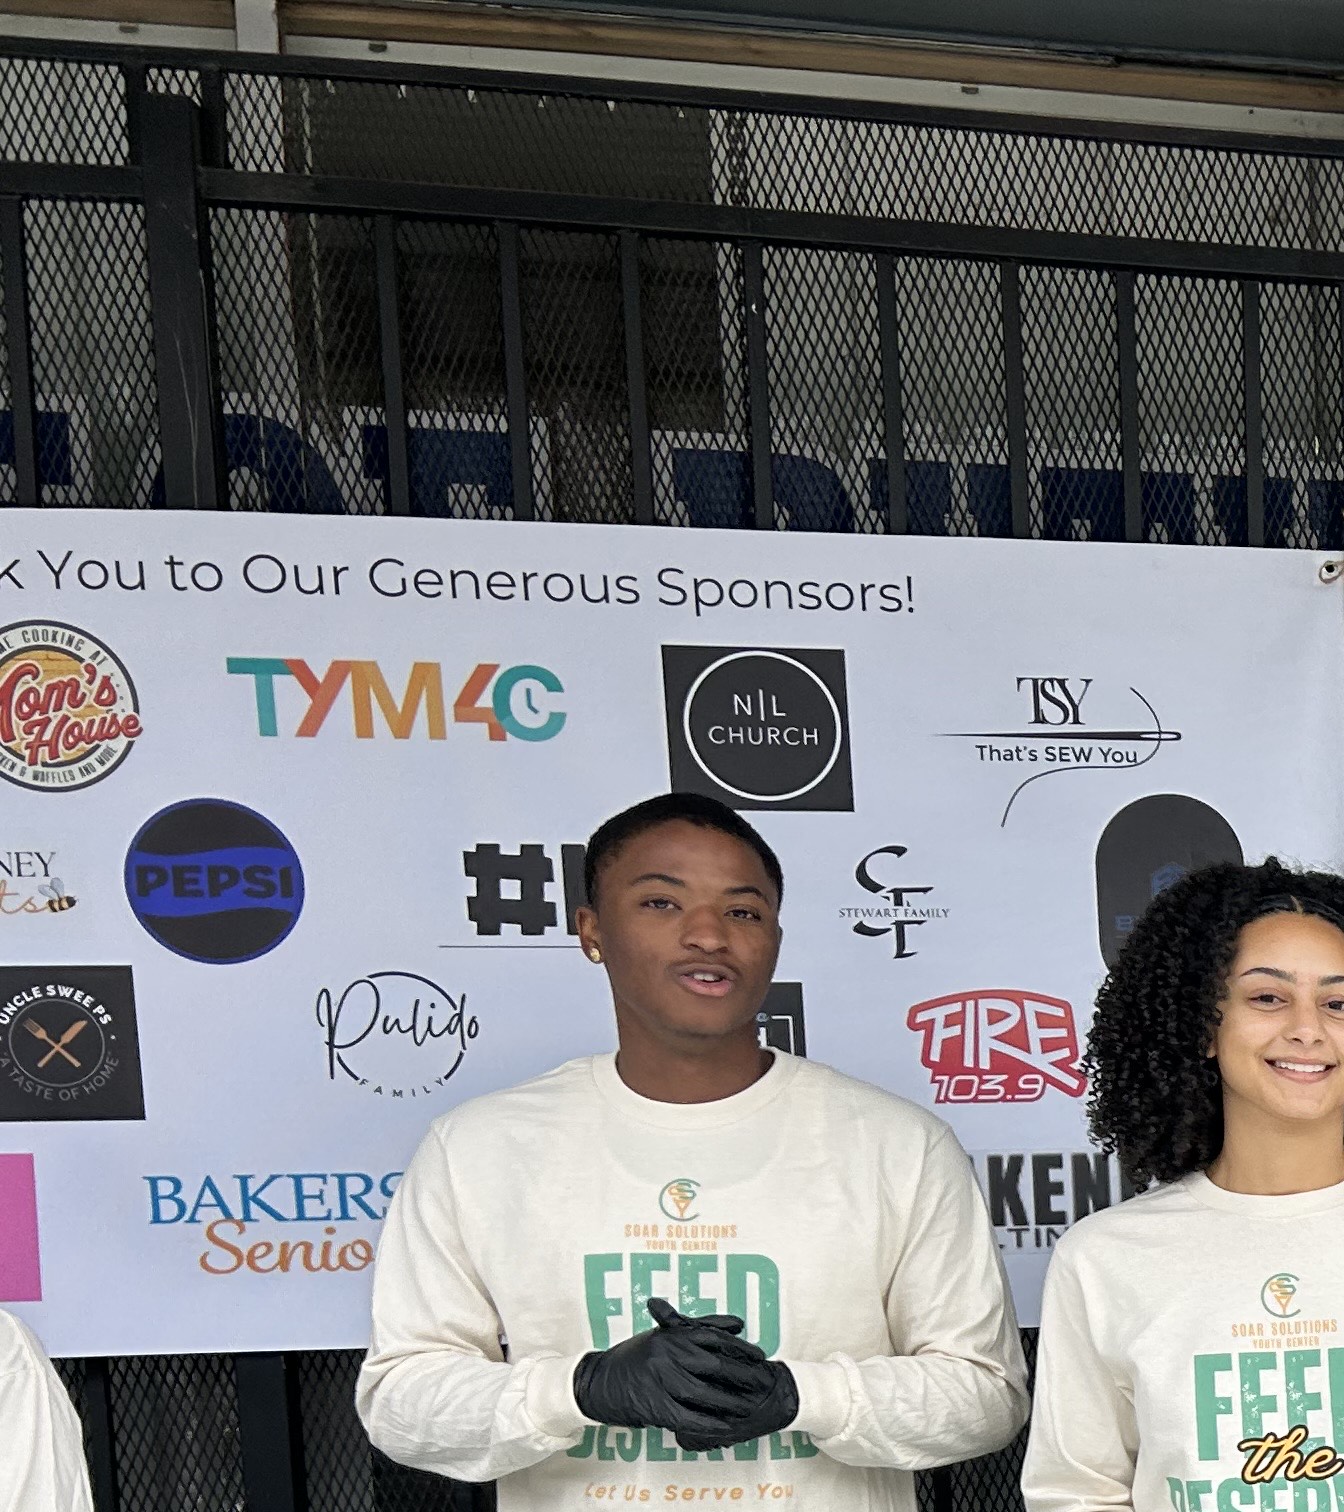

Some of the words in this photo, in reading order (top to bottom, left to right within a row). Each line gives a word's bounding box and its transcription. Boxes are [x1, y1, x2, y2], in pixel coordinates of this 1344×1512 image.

[37, 549, 146, 591] You
[165, 554, 223, 592] to
[243, 553, 349, 596] Our
[369, 557, 641, 605] Generous
[657, 567, 915, 617] Sponsors!
[21, 628, 85, 651] COOKING
[89, 650, 108, 666] AT
[226, 656, 567, 742] TYM4C
[1016, 676, 1093, 725] TSY
[23, 713, 143, 767] House
[707, 725, 819, 746] CHURCH
[975, 744, 1038, 762] That's
[1044, 746, 1094, 763] SEW
[1098, 746, 1138, 764] You
[32, 768, 76, 784] WAFFLES
[135, 864, 294, 899] PEPSI
[838, 908, 900, 919] STEWART
[904, 908, 951, 919] FAMILY
[316, 979, 480, 1080] Pulido
[914, 997, 1081, 1090] FIRE
[8, 1067, 53, 1101] TASTE
[58, 1086, 80, 1102] OF
[358, 1076, 445, 1099] FAMILY
[933, 1073, 1046, 1102] 103.9
[666, 1224, 738, 1239] SOLUTIONS
[583, 1252, 780, 1361] FEED
[1231, 1321, 1265, 1338] SOAR
[1271, 1318, 1338, 1337] SOLUTIONS
[624, 1483, 651, 1501] Us
[664, 1484, 743, 1501] Serve
[757, 1482, 795, 1499] You
